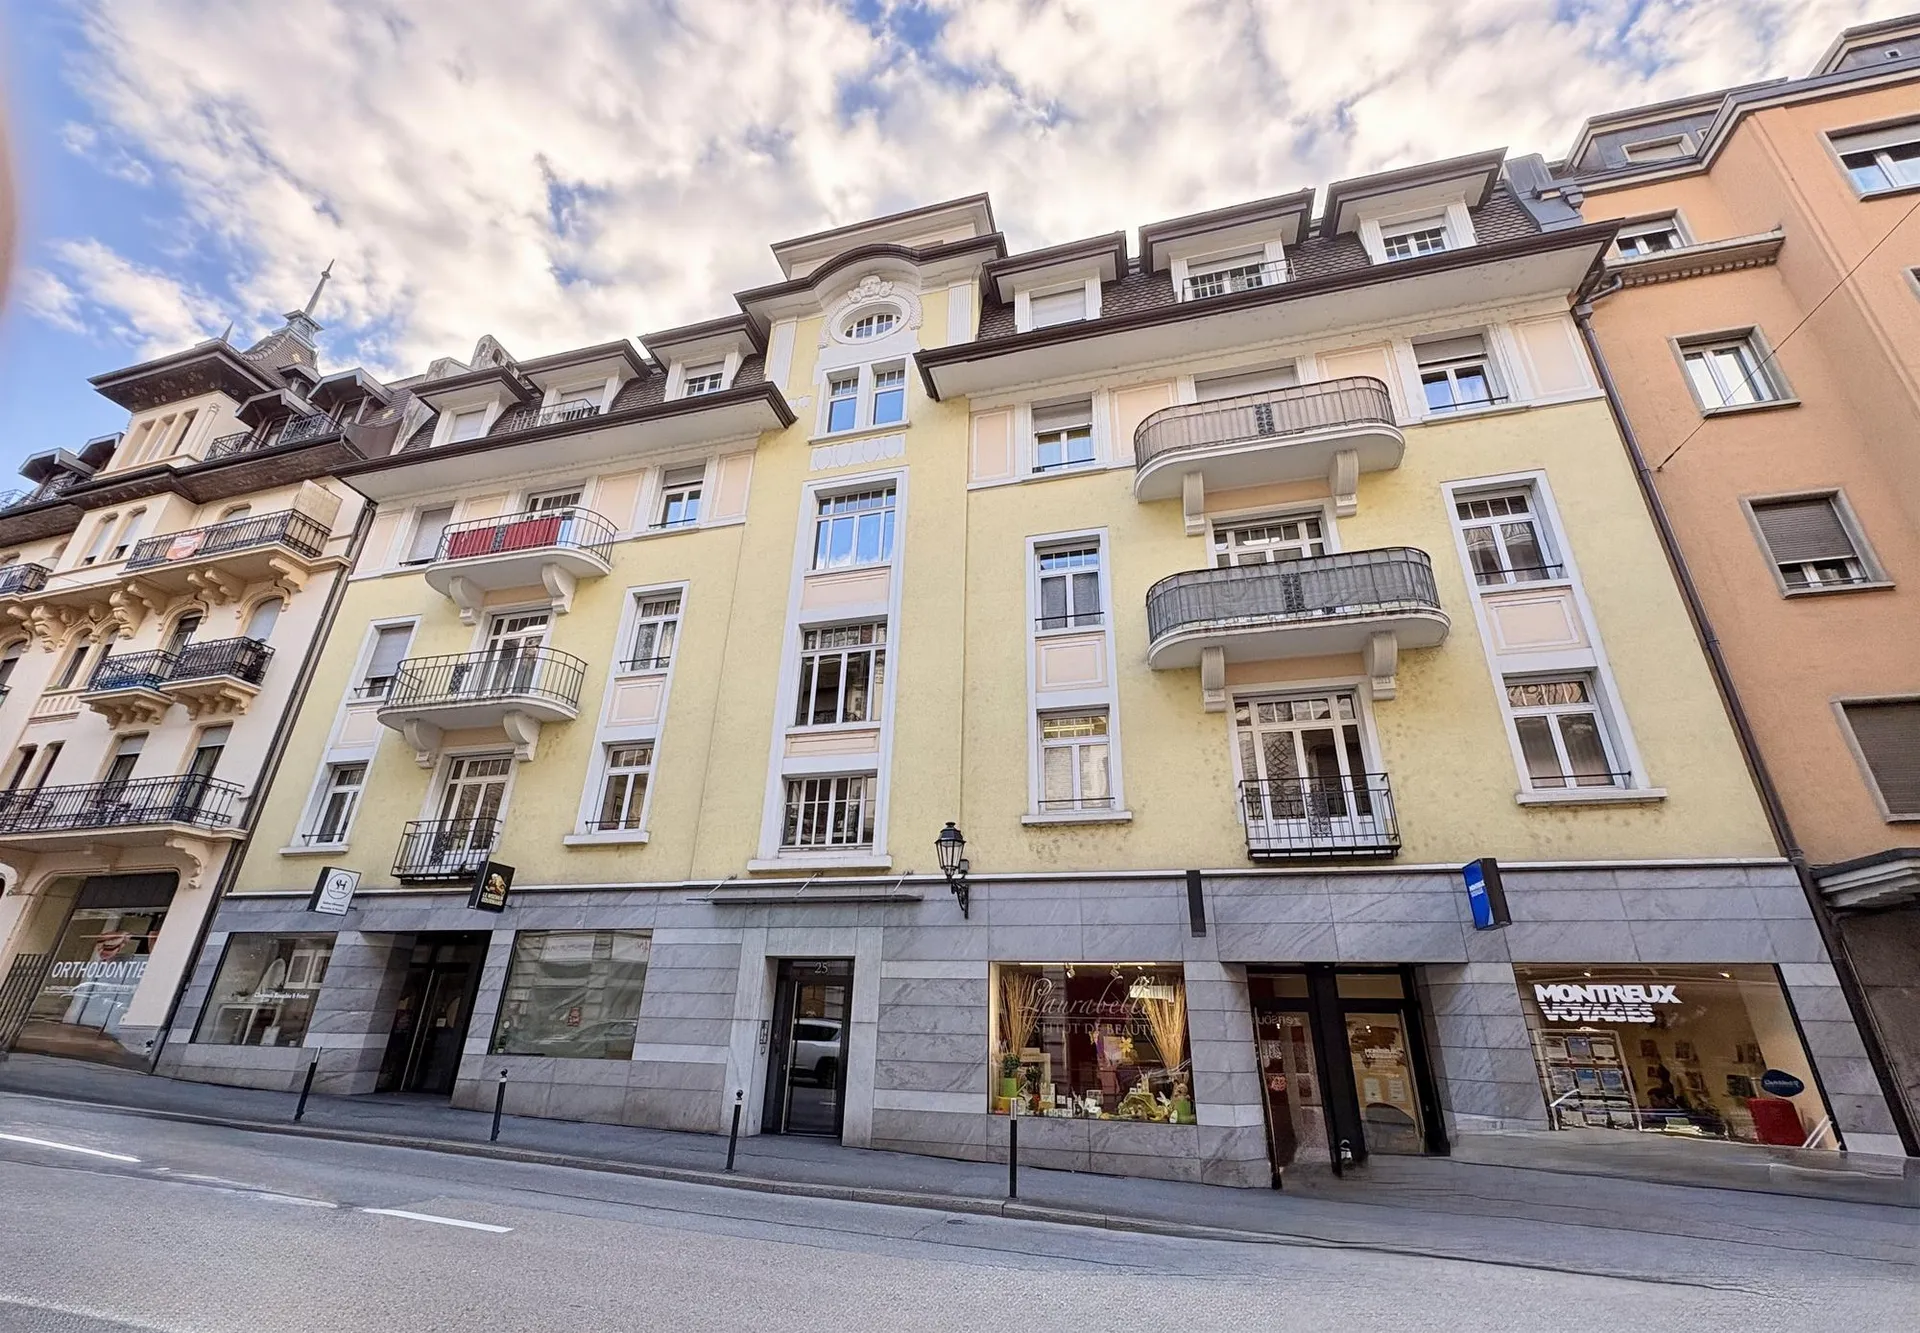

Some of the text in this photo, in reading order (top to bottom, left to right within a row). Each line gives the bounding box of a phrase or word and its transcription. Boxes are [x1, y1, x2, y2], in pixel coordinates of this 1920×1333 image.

[51, 961, 148, 979] ORTHODONTIE
[814, 961, 829, 974] 25
[1533, 984, 1683, 1004] MONTREUX
[1538, 1003, 1656, 1023] VOYAGES
